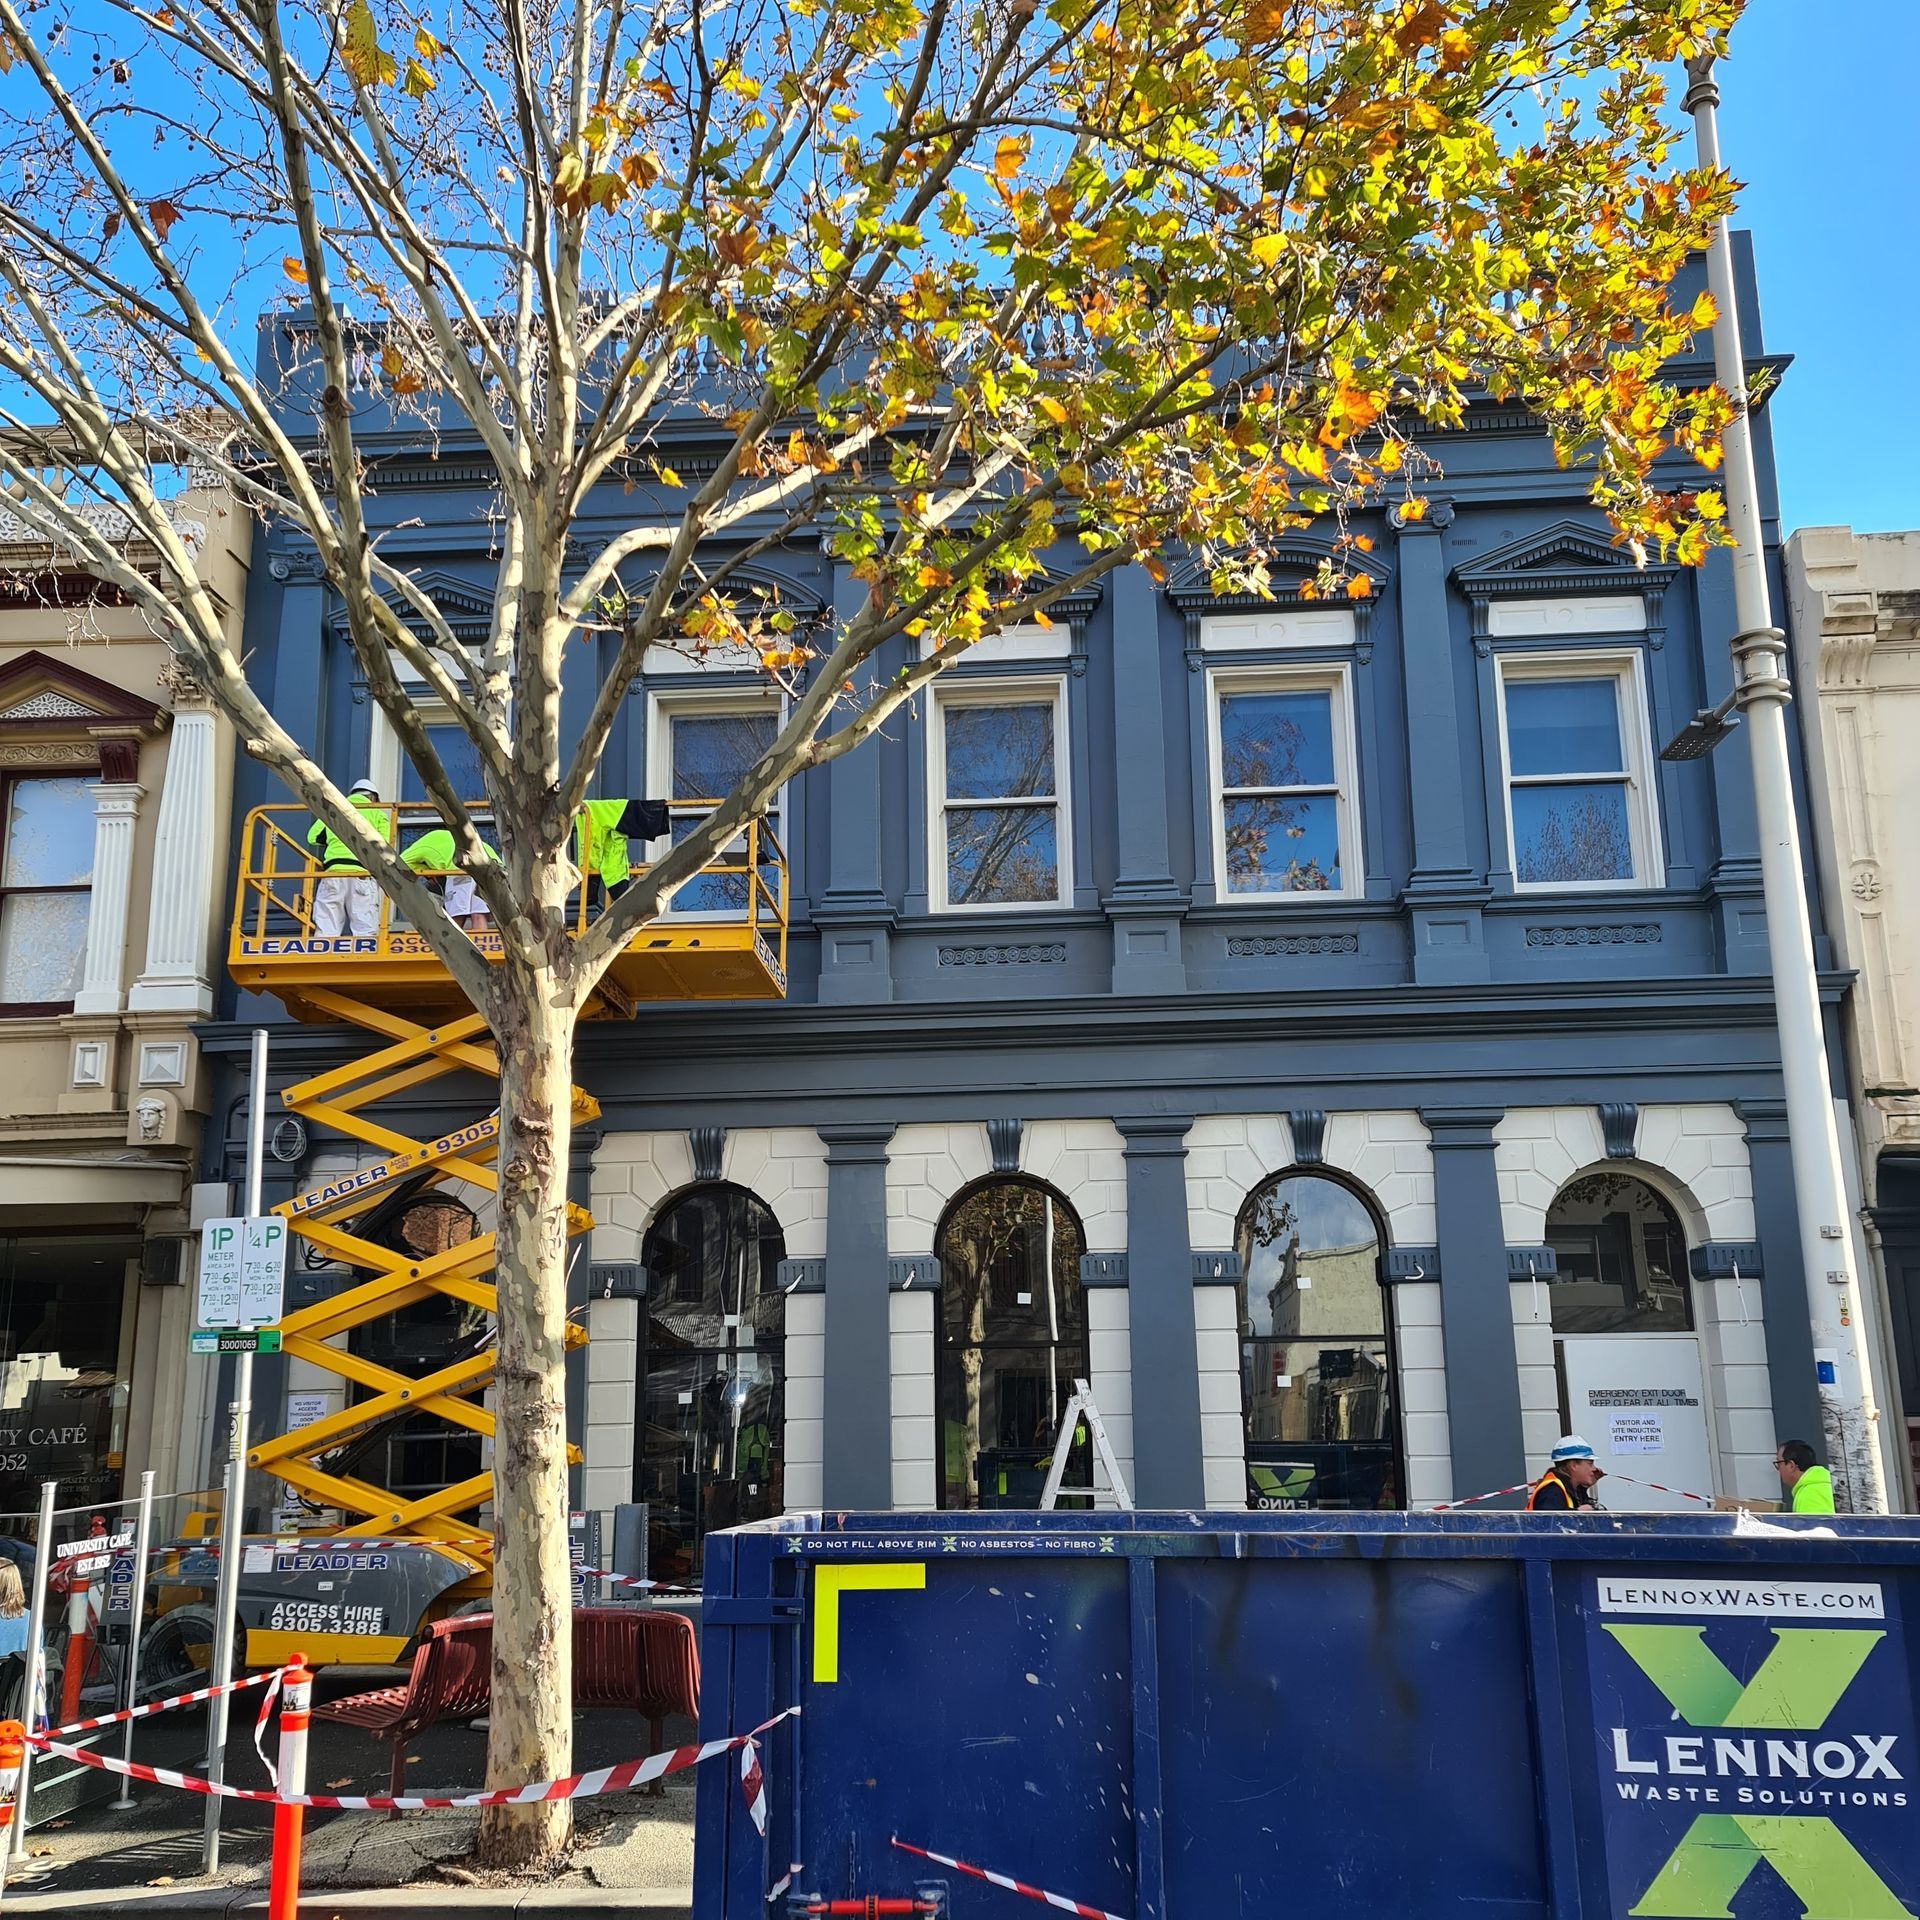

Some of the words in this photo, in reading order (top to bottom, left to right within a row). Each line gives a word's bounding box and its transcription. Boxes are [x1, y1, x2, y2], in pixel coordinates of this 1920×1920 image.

[242, 938, 377, 955] LEADER
[753, 929, 785, 991] LEADER
[291, 1165, 389, 1214] LEADER
[210, 1227, 234, 1250] 1P
[208, 1252, 234, 1261] METER
[220, 1340, 257, 1350] 30001069
[1588, 1389, 1639, 1398] EMERGENCY
[1641, 1389, 1659, 1397] EXIT
[1662, 1389, 1686, 1397] DOOR
[1589, 1399, 1611, 1407] KEEP
[1675, 1398, 1699, 1406] TIMES
[28, 1423, 87, 1445] CAFÉ
[57, 1535, 110, 1558] UNIVERSITY
[109, 1530, 132, 1548] CAFÉ
[807, 1541, 822, 1549] DO
[917, 1540, 937, 1548] RIM
[277, 1553, 388, 1572] LEADER
[271, 1602, 338, 1619] ACCESS
[343, 1605, 384, 1621] HIRE
[270, 1616, 382, 1635] 9305.3388
[1610, 1728, 1904, 1780] LENNOX
[1616, 1783, 1720, 1802] WASTE
[1738, 1787, 1908, 1806] SOLUTIONS
